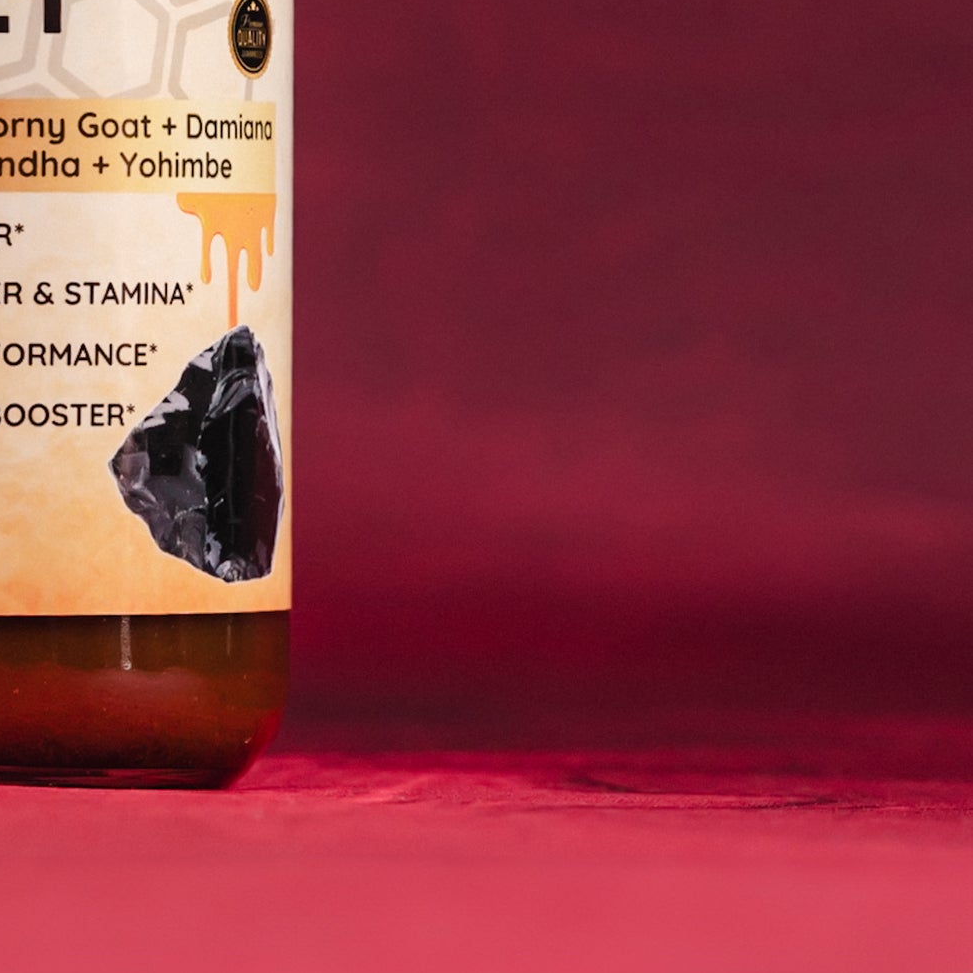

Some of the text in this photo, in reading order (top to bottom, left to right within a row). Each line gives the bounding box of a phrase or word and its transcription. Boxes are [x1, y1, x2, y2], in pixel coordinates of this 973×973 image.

[78, 113, 151, 139] Goat
[162, 118, 178, 135] +
[186, 114, 273, 141] Damiana
[93, 157, 109, 175] +
[120, 151, 233, 179] Yohimbe
[33, 282, 54, 305] &
